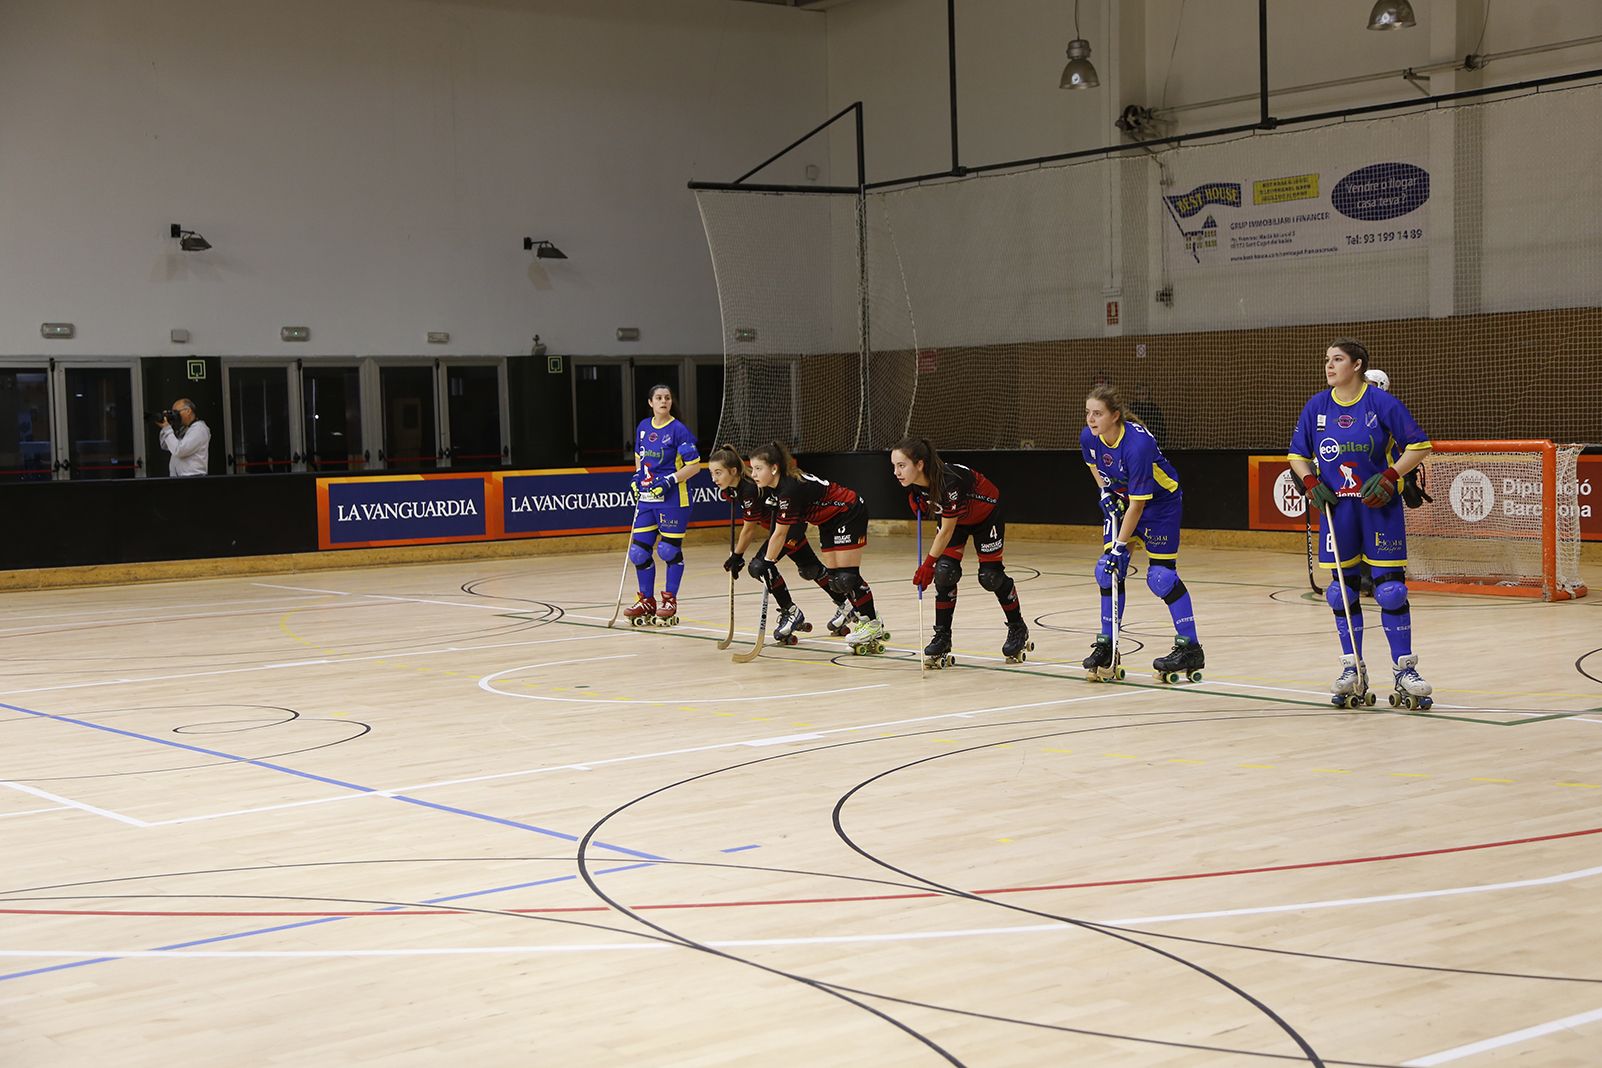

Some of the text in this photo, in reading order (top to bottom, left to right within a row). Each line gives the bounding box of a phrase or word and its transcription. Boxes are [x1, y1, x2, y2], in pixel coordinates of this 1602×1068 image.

[1176, 187, 1238, 212] BEST HOUSE
[1356, 198, 1377, 209] casa
[1296, 211, 1331, 223] FINANCER
[1346, 235, 1362, 246] Tel:
[1363, 232, 1375, 244] 93
[1377, 230, 1395, 243] 199
[1397, 228, 1410, 240] 14
[1320, 441, 1370, 455] ecopilas
[337, 498, 477, 521] LA VANGUARDIA
[513, 495, 533, 512] LA
[531, 491, 636, 511] VANGUARDIA
[989, 525, 998, 540] 4
